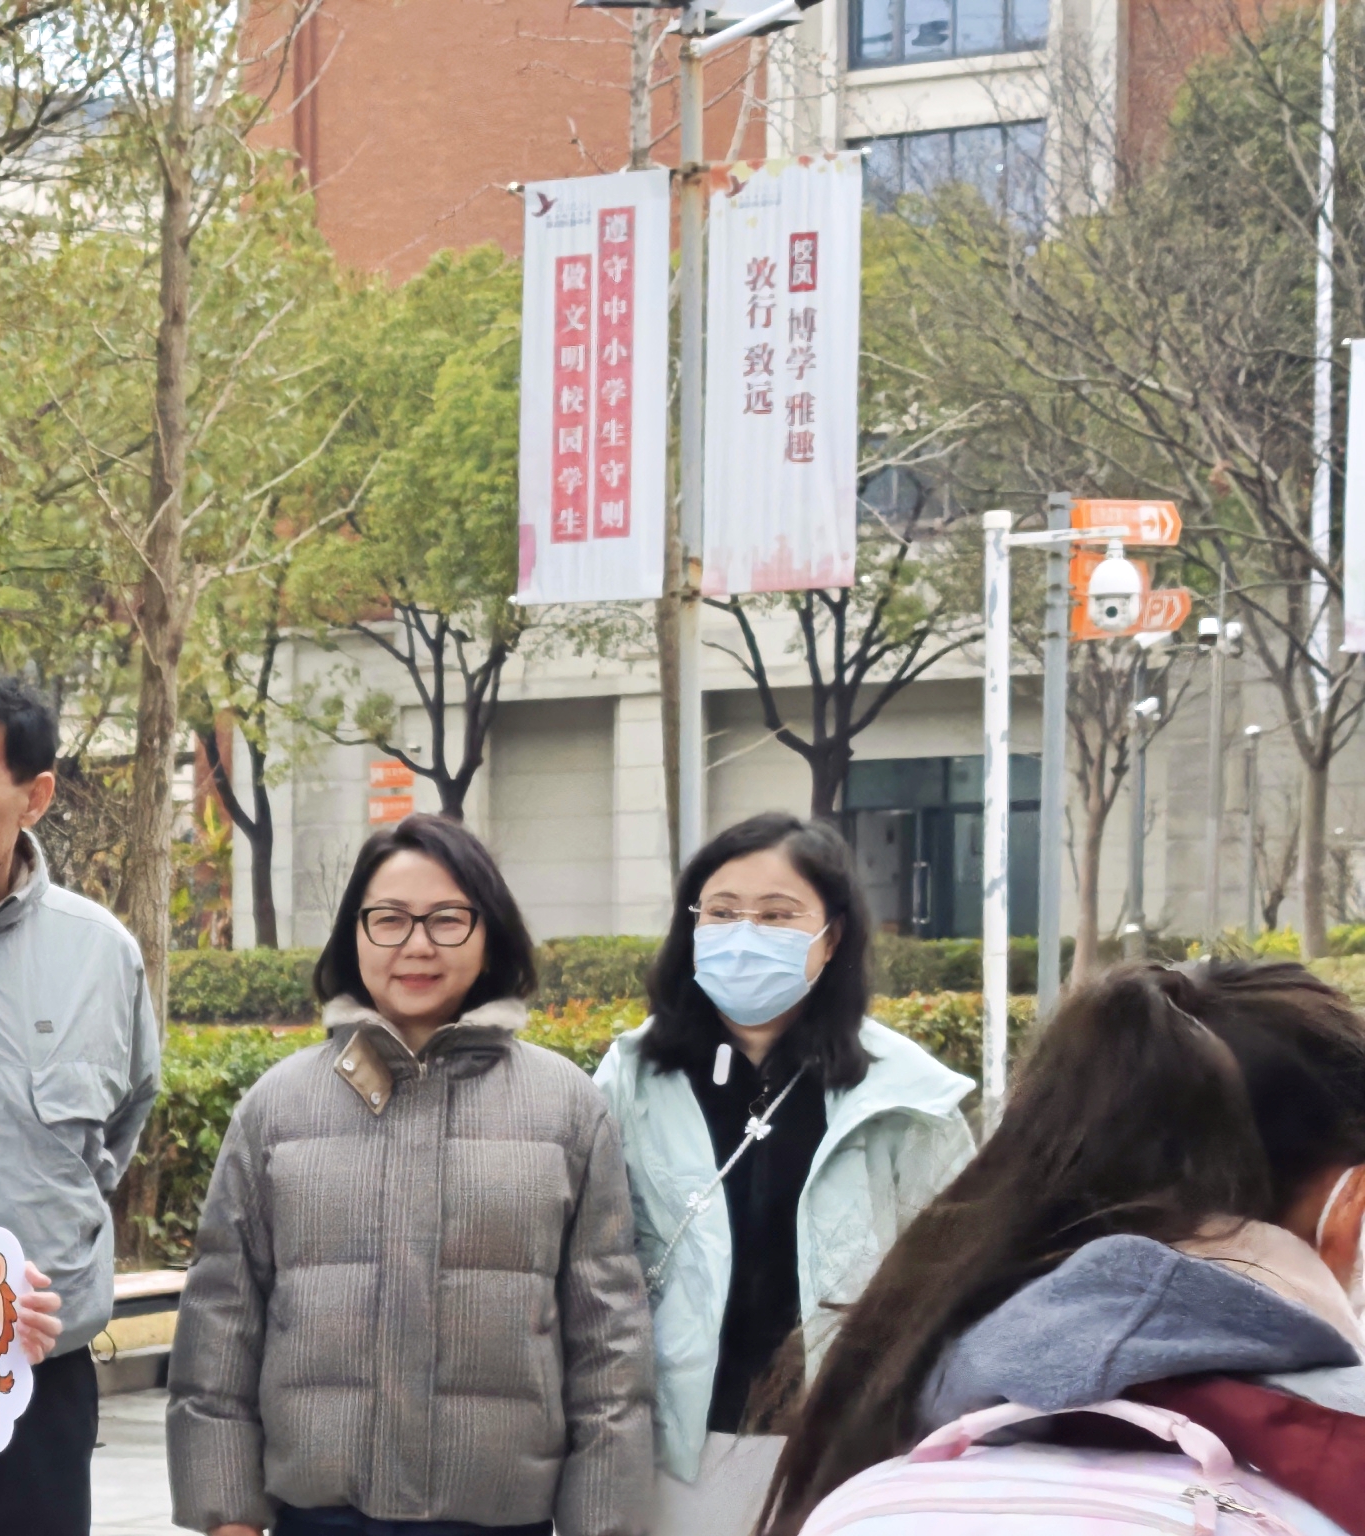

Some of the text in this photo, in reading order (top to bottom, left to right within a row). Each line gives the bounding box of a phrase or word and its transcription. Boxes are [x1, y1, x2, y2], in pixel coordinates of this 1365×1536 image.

[557, 263, 587, 536] 做文明校园学生
[599, 214, 628, 529] 遵守中小学生守则
